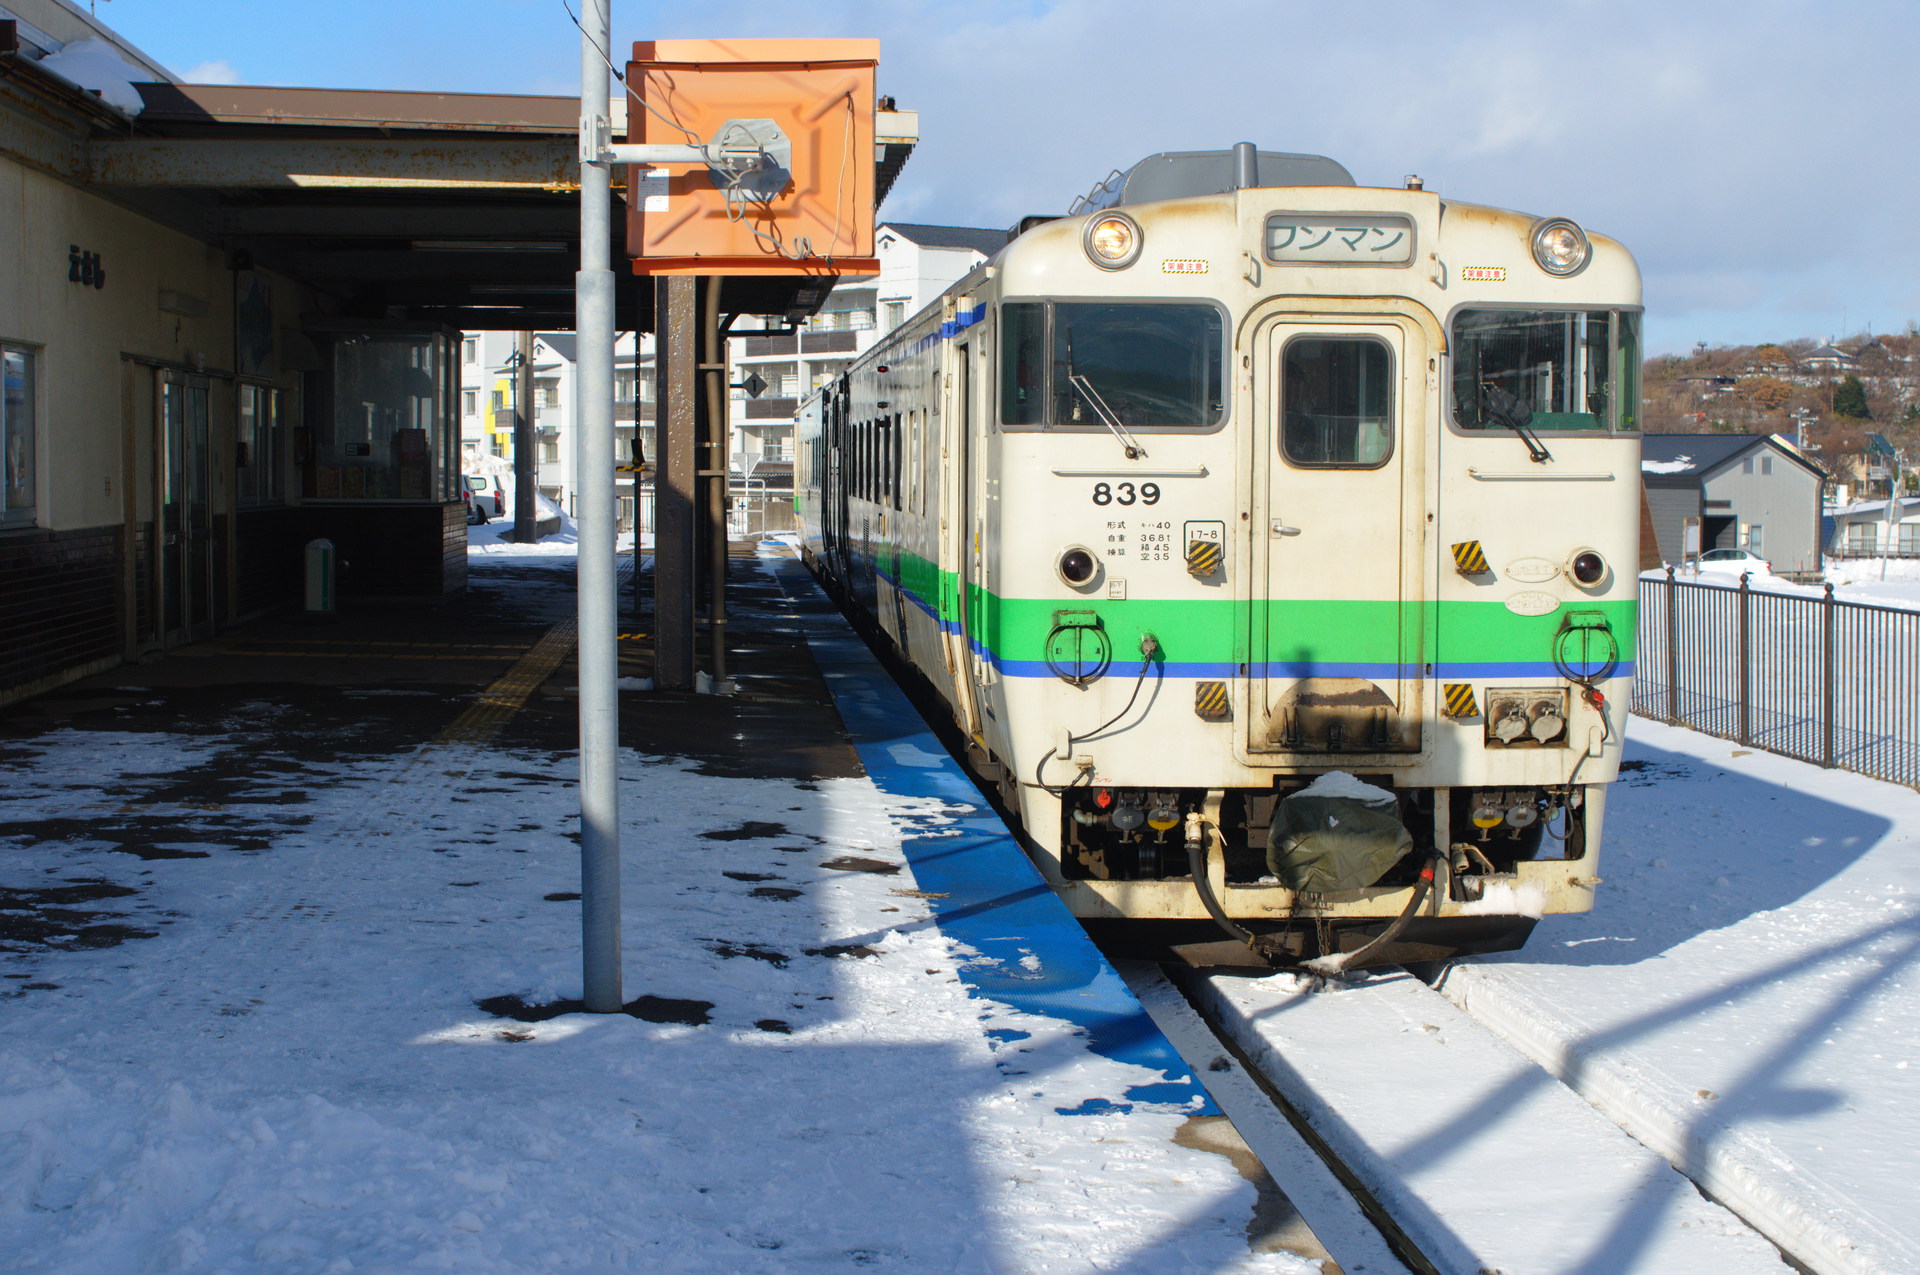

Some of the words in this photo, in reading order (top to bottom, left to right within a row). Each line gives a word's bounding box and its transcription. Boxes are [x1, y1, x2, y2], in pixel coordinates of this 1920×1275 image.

[1092, 482, 1161, 506] 839
[1106, 521, 1126, 530] 形式
[1107, 534, 1126, 542] 自重
[1190, 530, 1218, 539] 17-8
